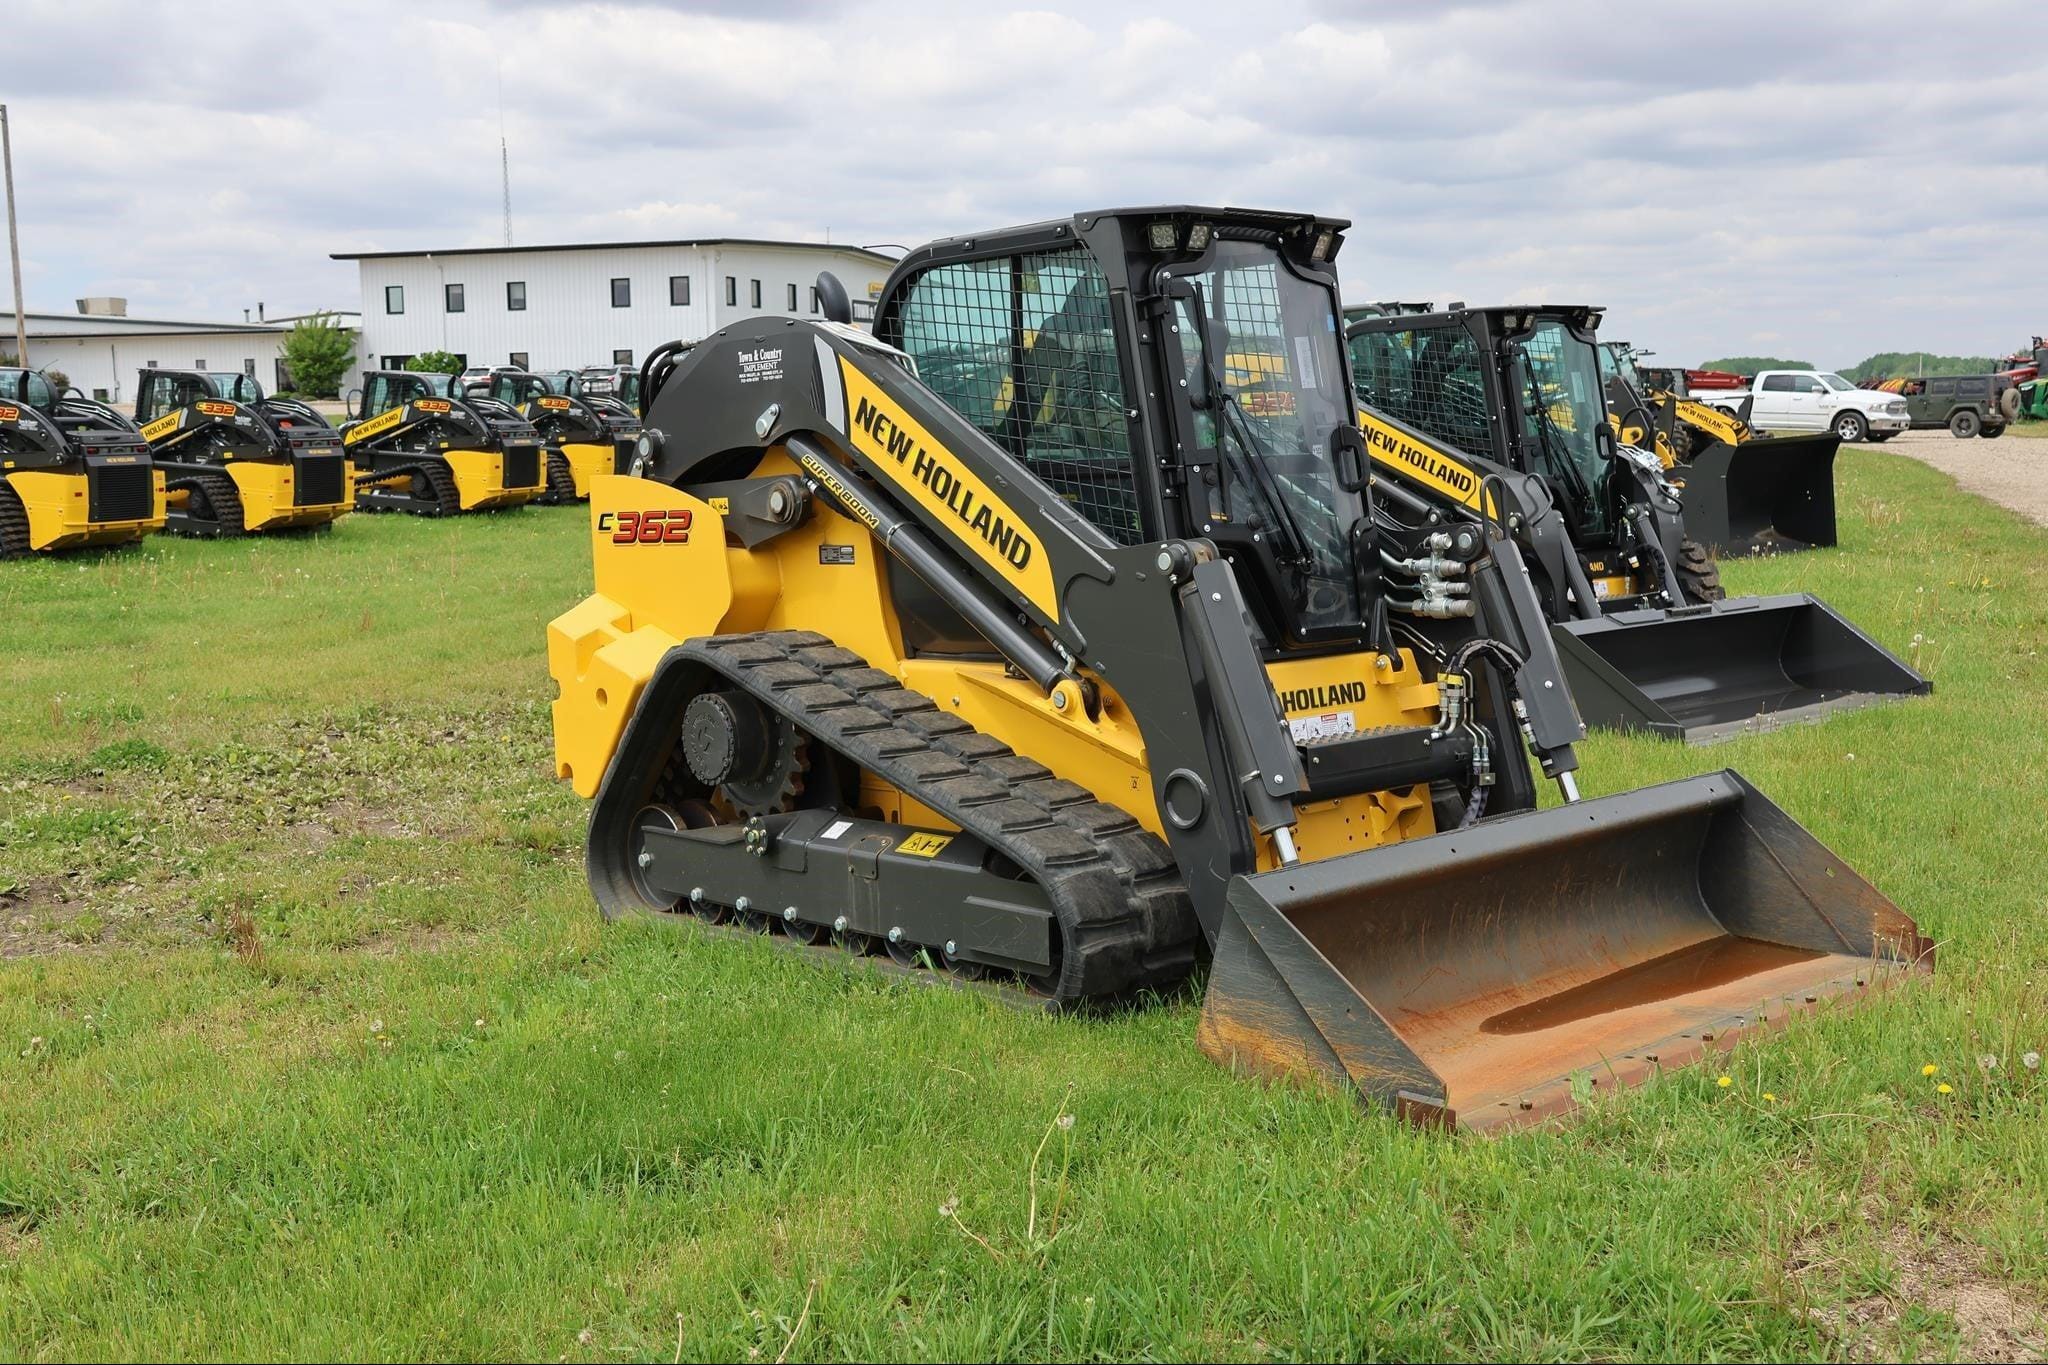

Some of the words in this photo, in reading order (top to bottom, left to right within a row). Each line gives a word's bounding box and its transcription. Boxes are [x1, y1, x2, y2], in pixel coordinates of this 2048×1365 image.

[760, 348, 782, 361] Country
[743, 361, 778, 372] IMPLEMENT
[1681, 405, 1696, 417] NEW
[144, 417, 176, 437] HOLLAND
[370, 414, 399, 431] HOLLAND
[1363, 424, 1397, 454] NEW
[1398, 443, 1472, 493] HOLLAND
[855, 396, 914, 464] NEW
[912, 448, 1031, 570] HOLLAND
[598, 510, 693, 544] C362
[1281, 681, 1366, 712] HOLLAND
